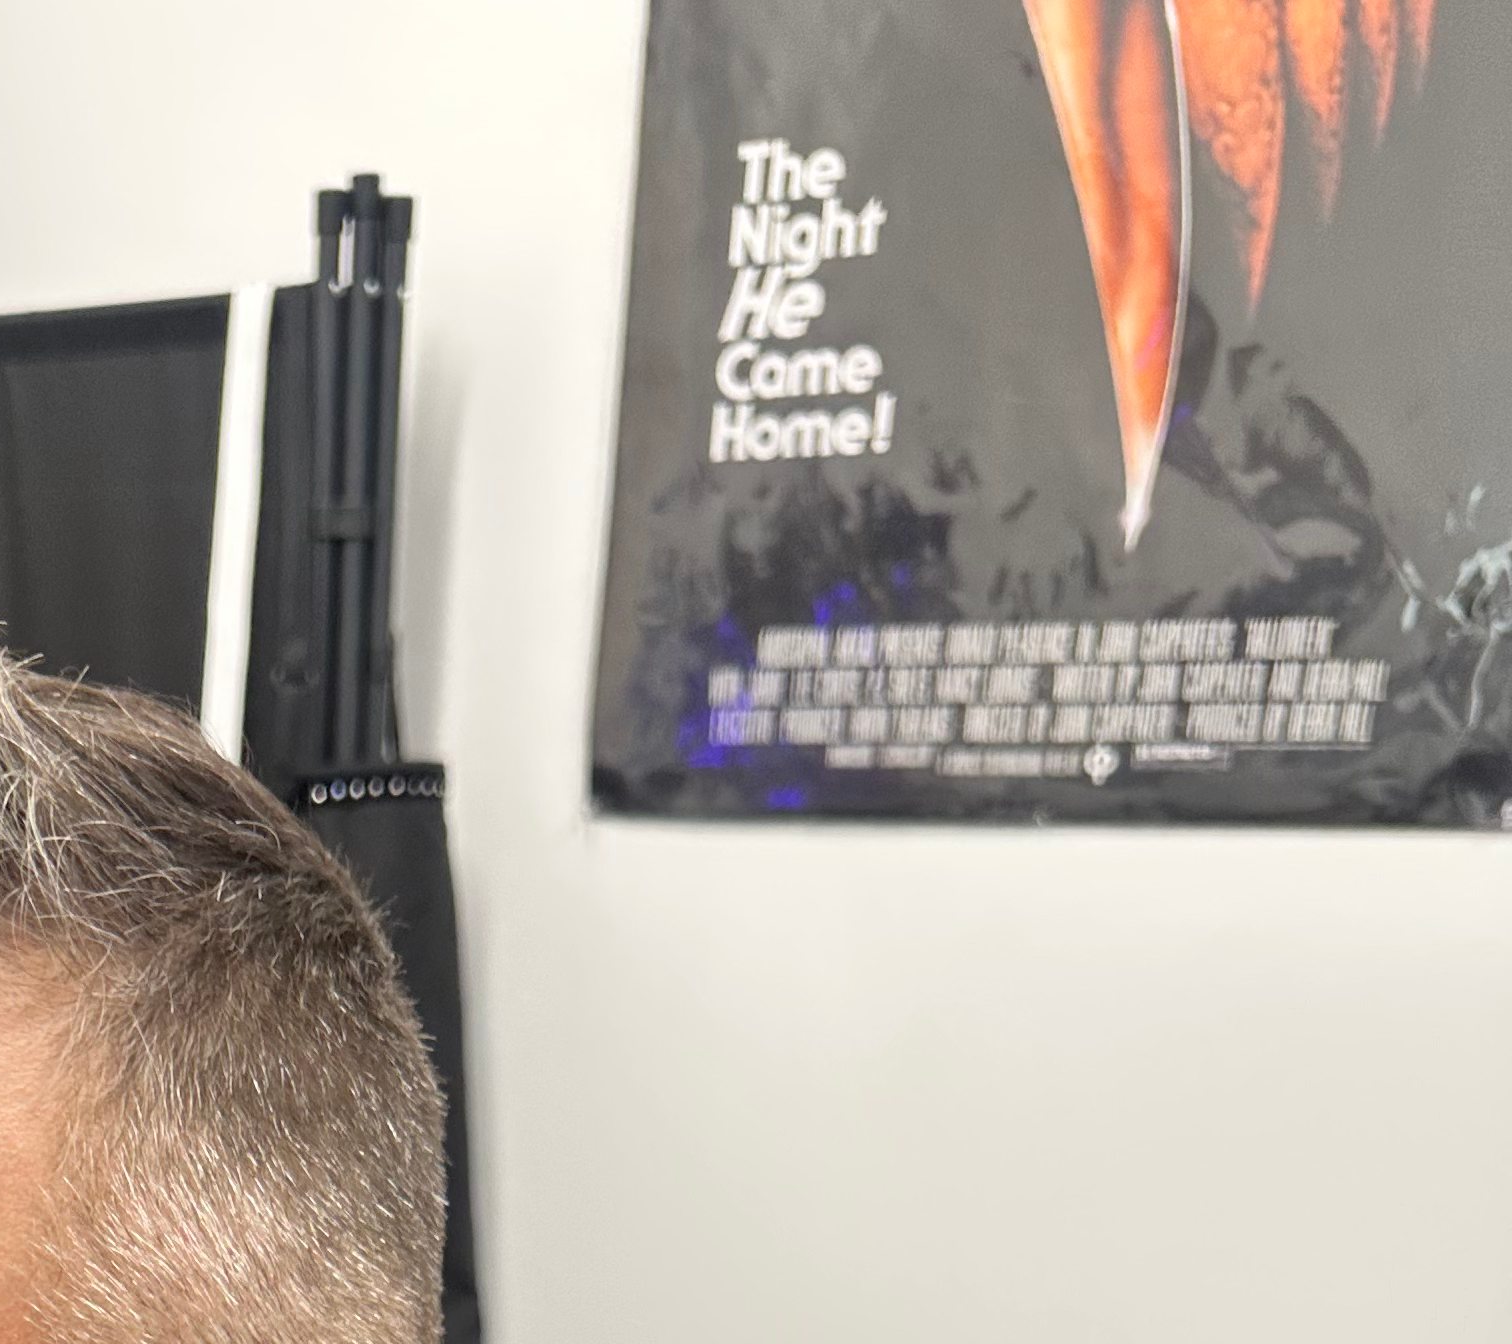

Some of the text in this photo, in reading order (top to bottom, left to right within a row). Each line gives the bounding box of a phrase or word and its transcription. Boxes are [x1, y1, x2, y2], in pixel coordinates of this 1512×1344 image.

[737, 137, 846, 203] The
[728, 196, 887, 277] Night
[718, 267, 825, 342] He
[715, 342, 883, 401] Came
[709, 392, 896, 462] Home!
